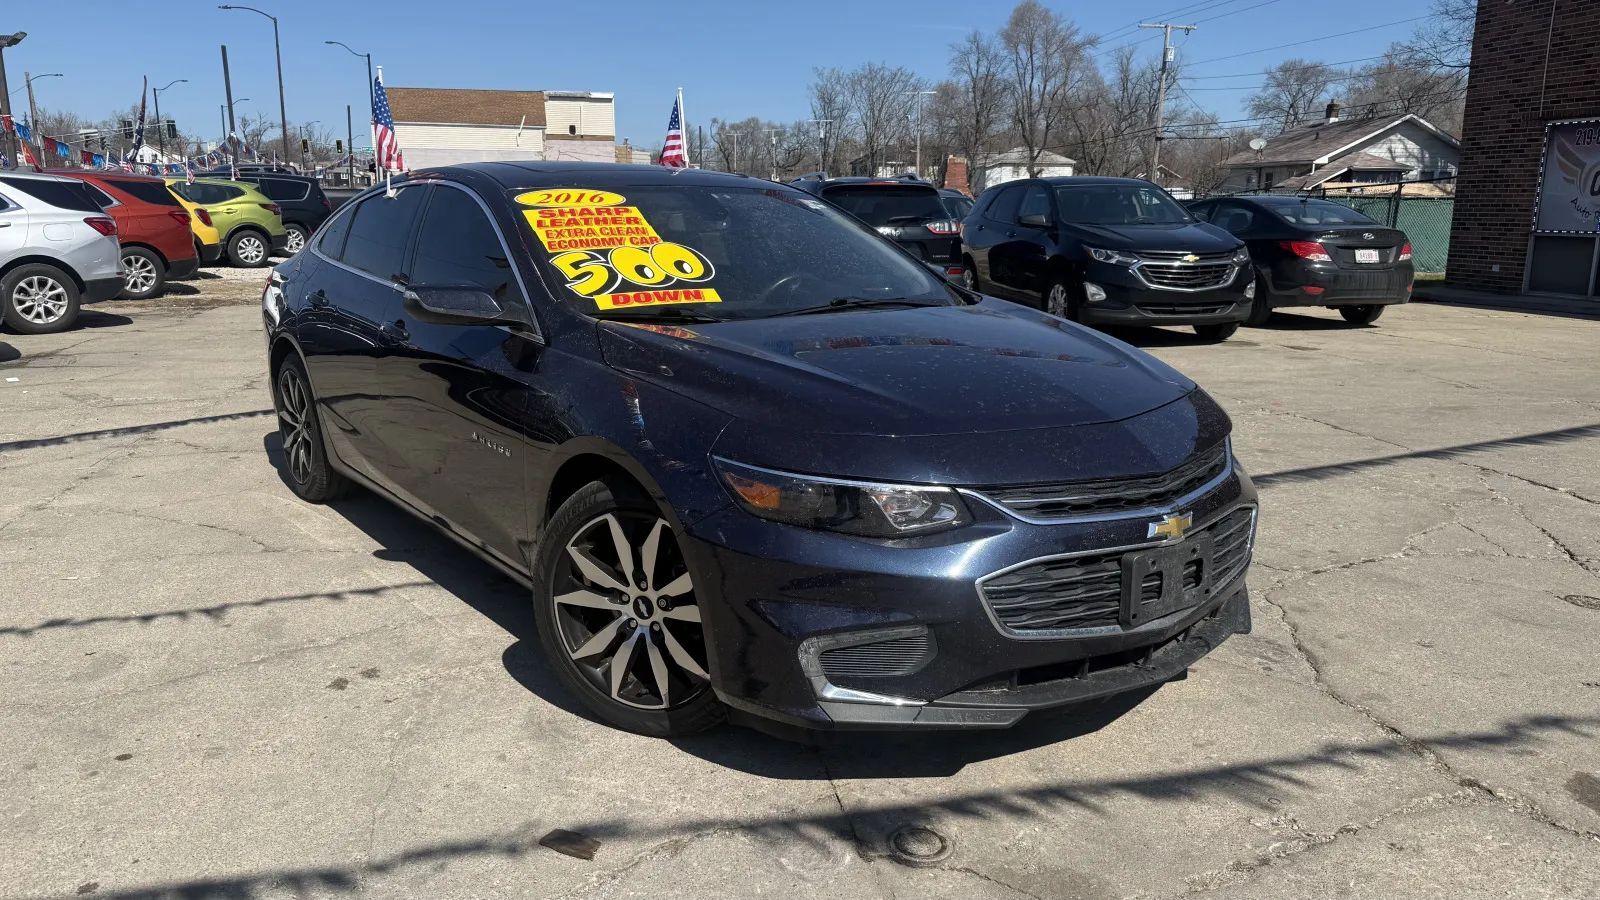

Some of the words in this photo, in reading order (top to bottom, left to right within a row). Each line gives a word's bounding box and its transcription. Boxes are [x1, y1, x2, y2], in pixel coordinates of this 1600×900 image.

[536, 193, 604, 204] 2016
[538, 207, 632, 218] SHARP
[536, 216, 642, 228] LEATHER
[545, 228, 597, 239] EXTRA
[599, 227, 648, 237] CLEAN
[547, 237, 626, 250] ECONOMY
[629, 236, 662, 246] CAR
[550, 242, 715, 297] 500
[611, 289, 705, 306] DOWN
